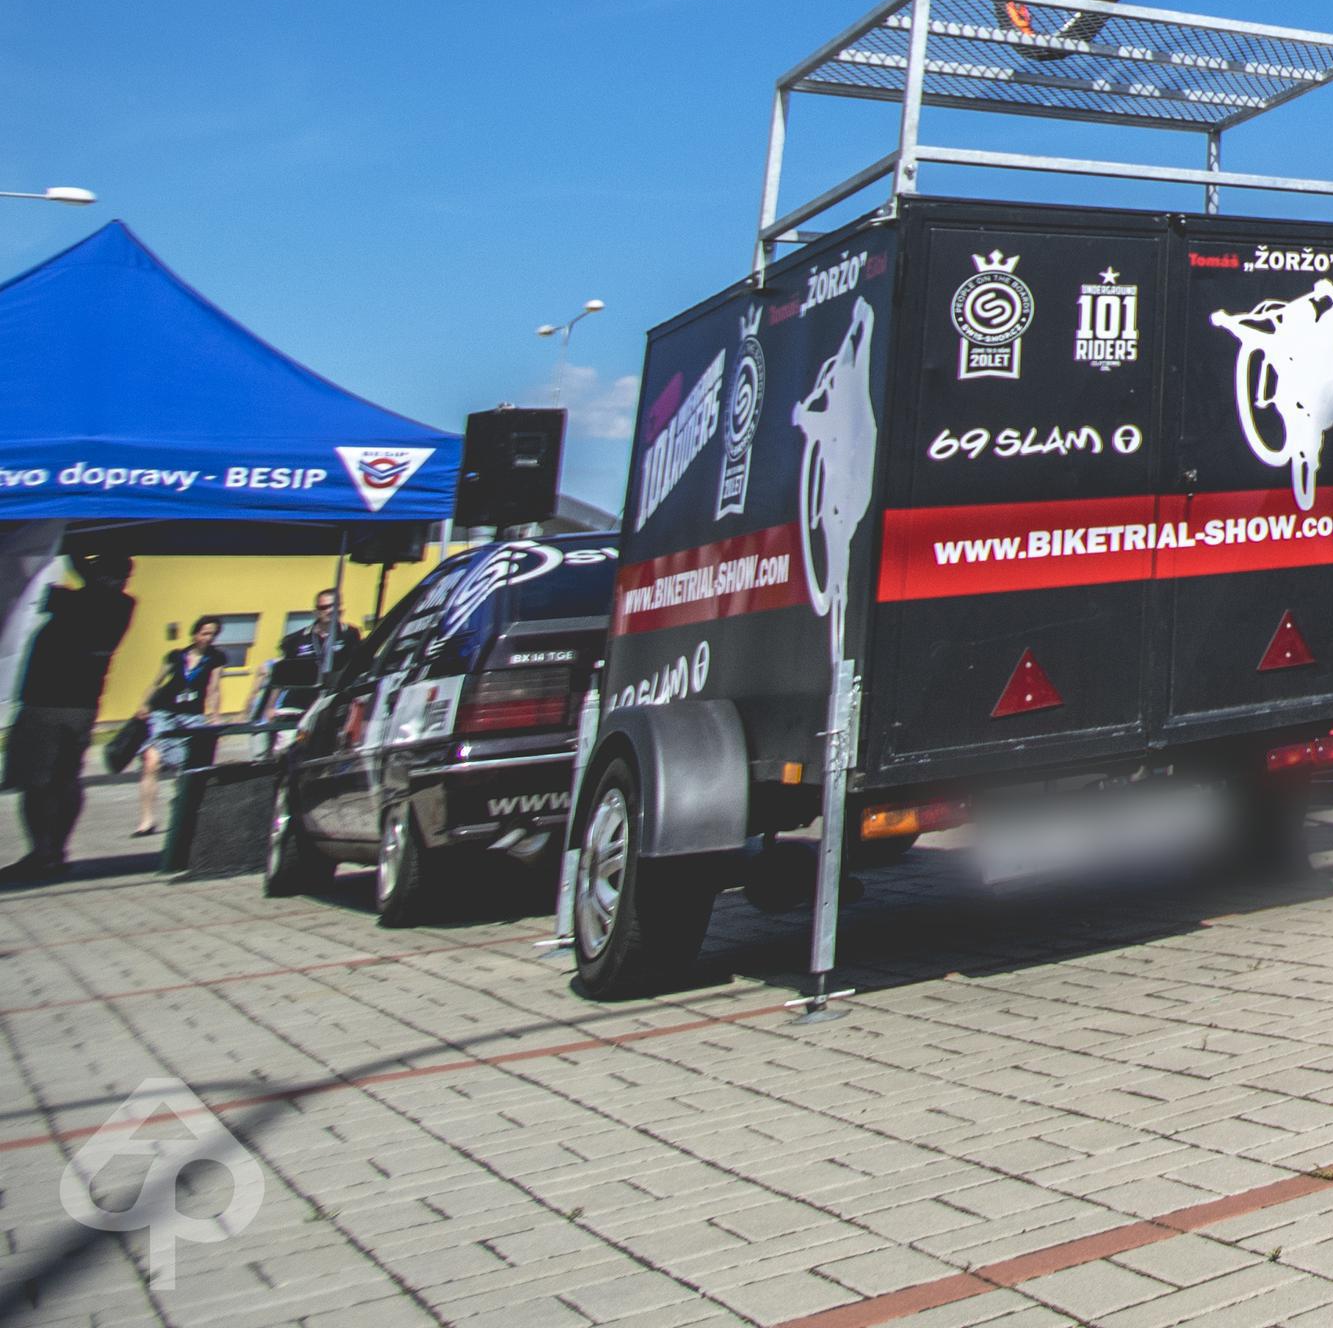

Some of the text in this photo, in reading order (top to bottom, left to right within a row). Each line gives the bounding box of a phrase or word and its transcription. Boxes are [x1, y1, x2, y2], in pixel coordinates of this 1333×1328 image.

[993, 274, 1011, 284] THE
[1075, 294, 1139, 340] 101
[1074, 339, 1138, 362] RIDERS
[927, 424, 1104, 460] 69 SLAM
[58, 461, 200, 492] dopravy
[224, 467, 327, 490] BESIP
[547, 650, 575, 662] TGE
